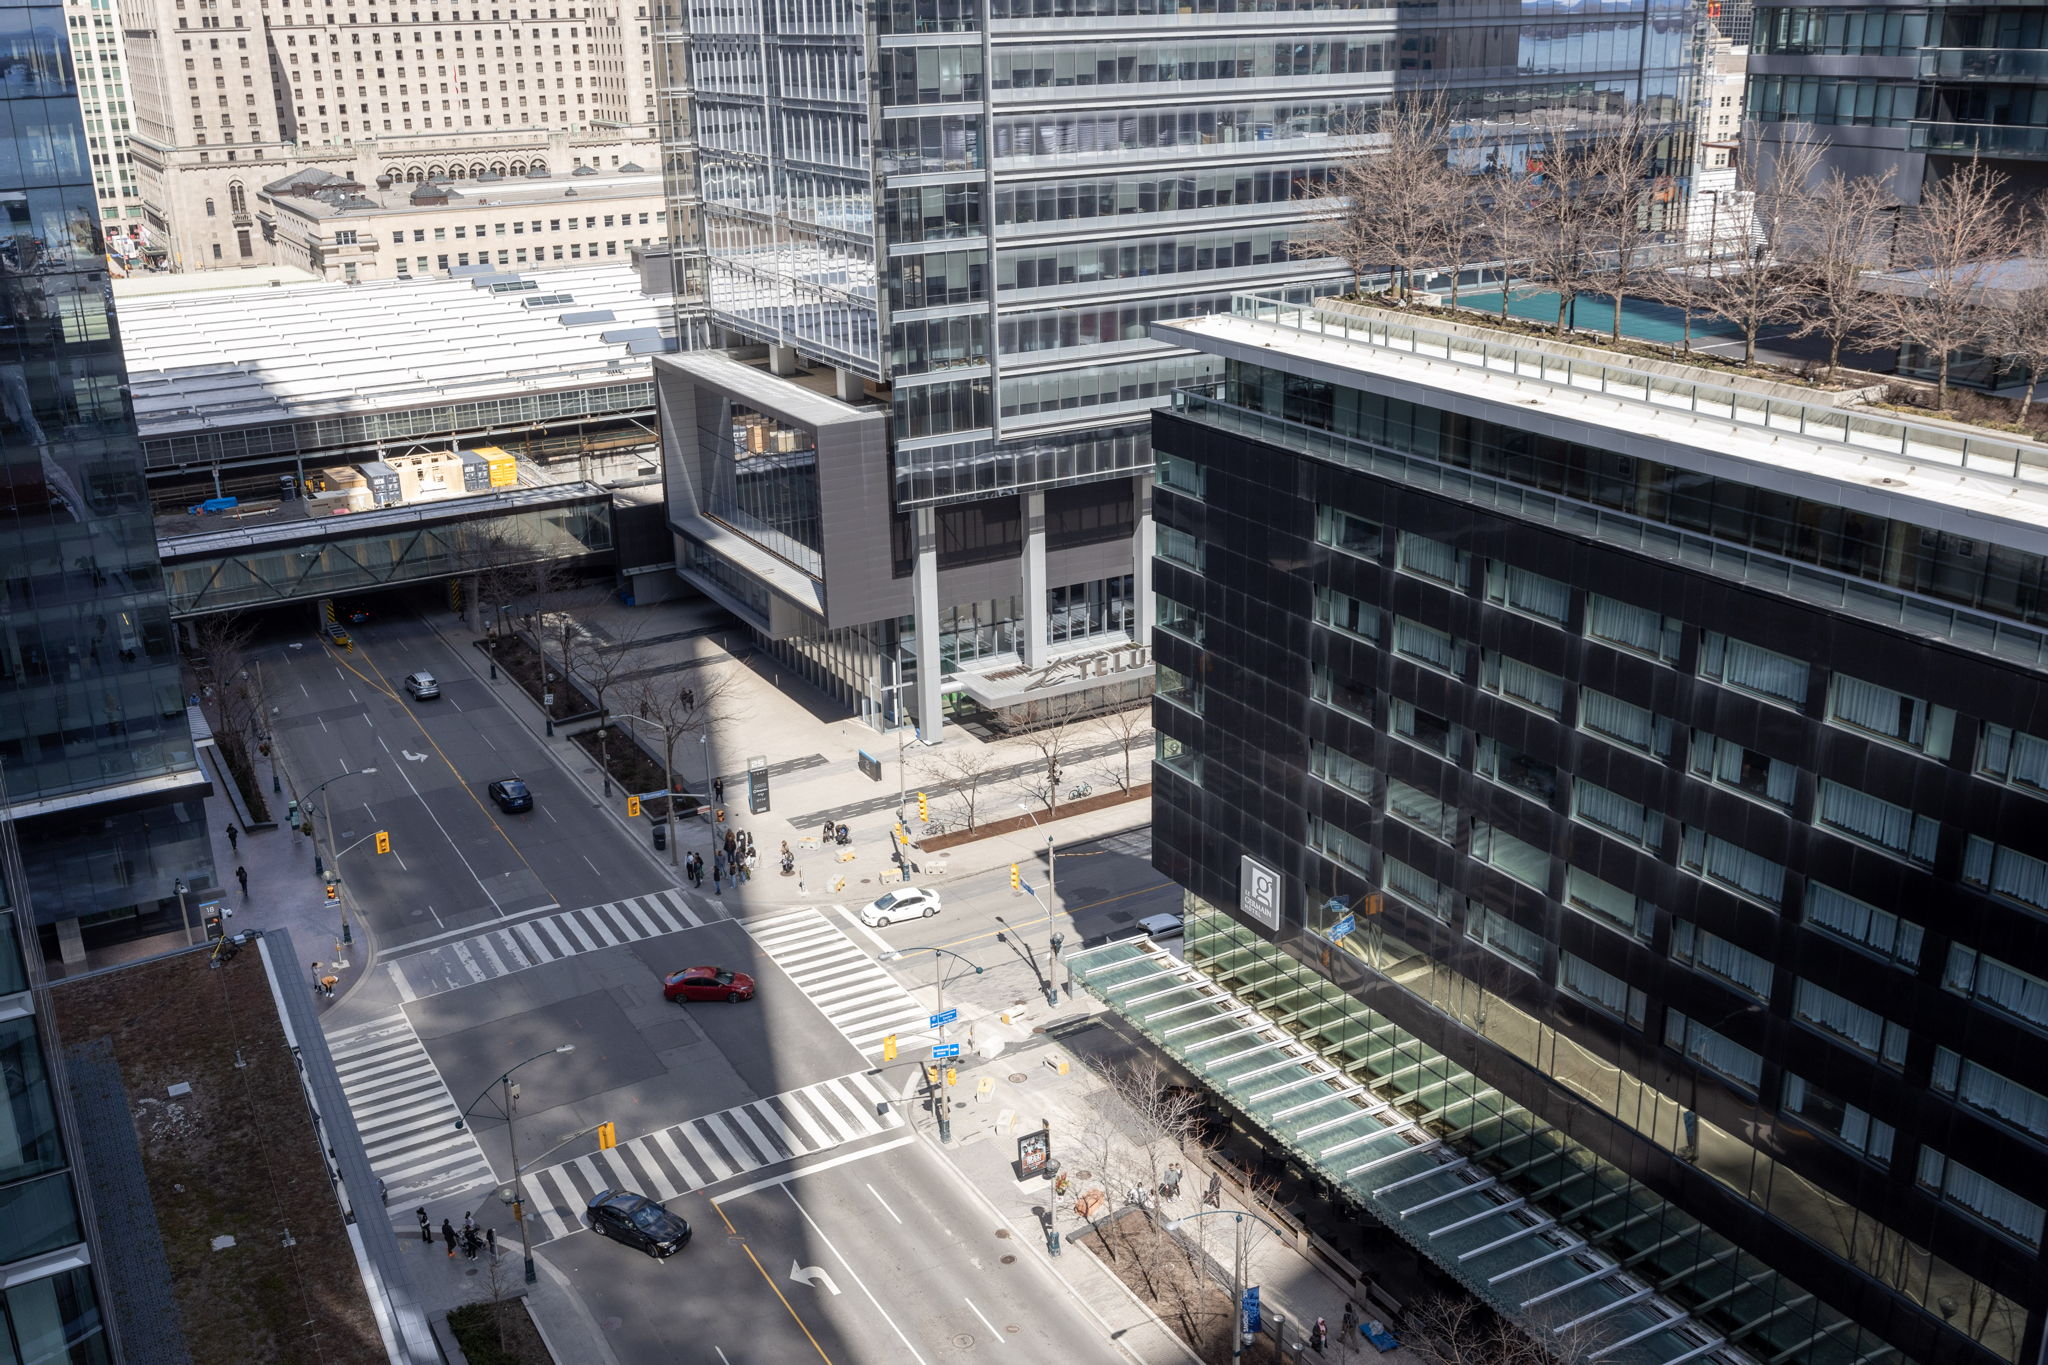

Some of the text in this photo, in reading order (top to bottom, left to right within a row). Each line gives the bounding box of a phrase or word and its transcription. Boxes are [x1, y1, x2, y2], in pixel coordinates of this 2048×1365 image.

[1075, 647, 1152, 680] TELU
[751, 759, 765, 769] 25
[1244, 896, 1272, 918] GERMAIN
